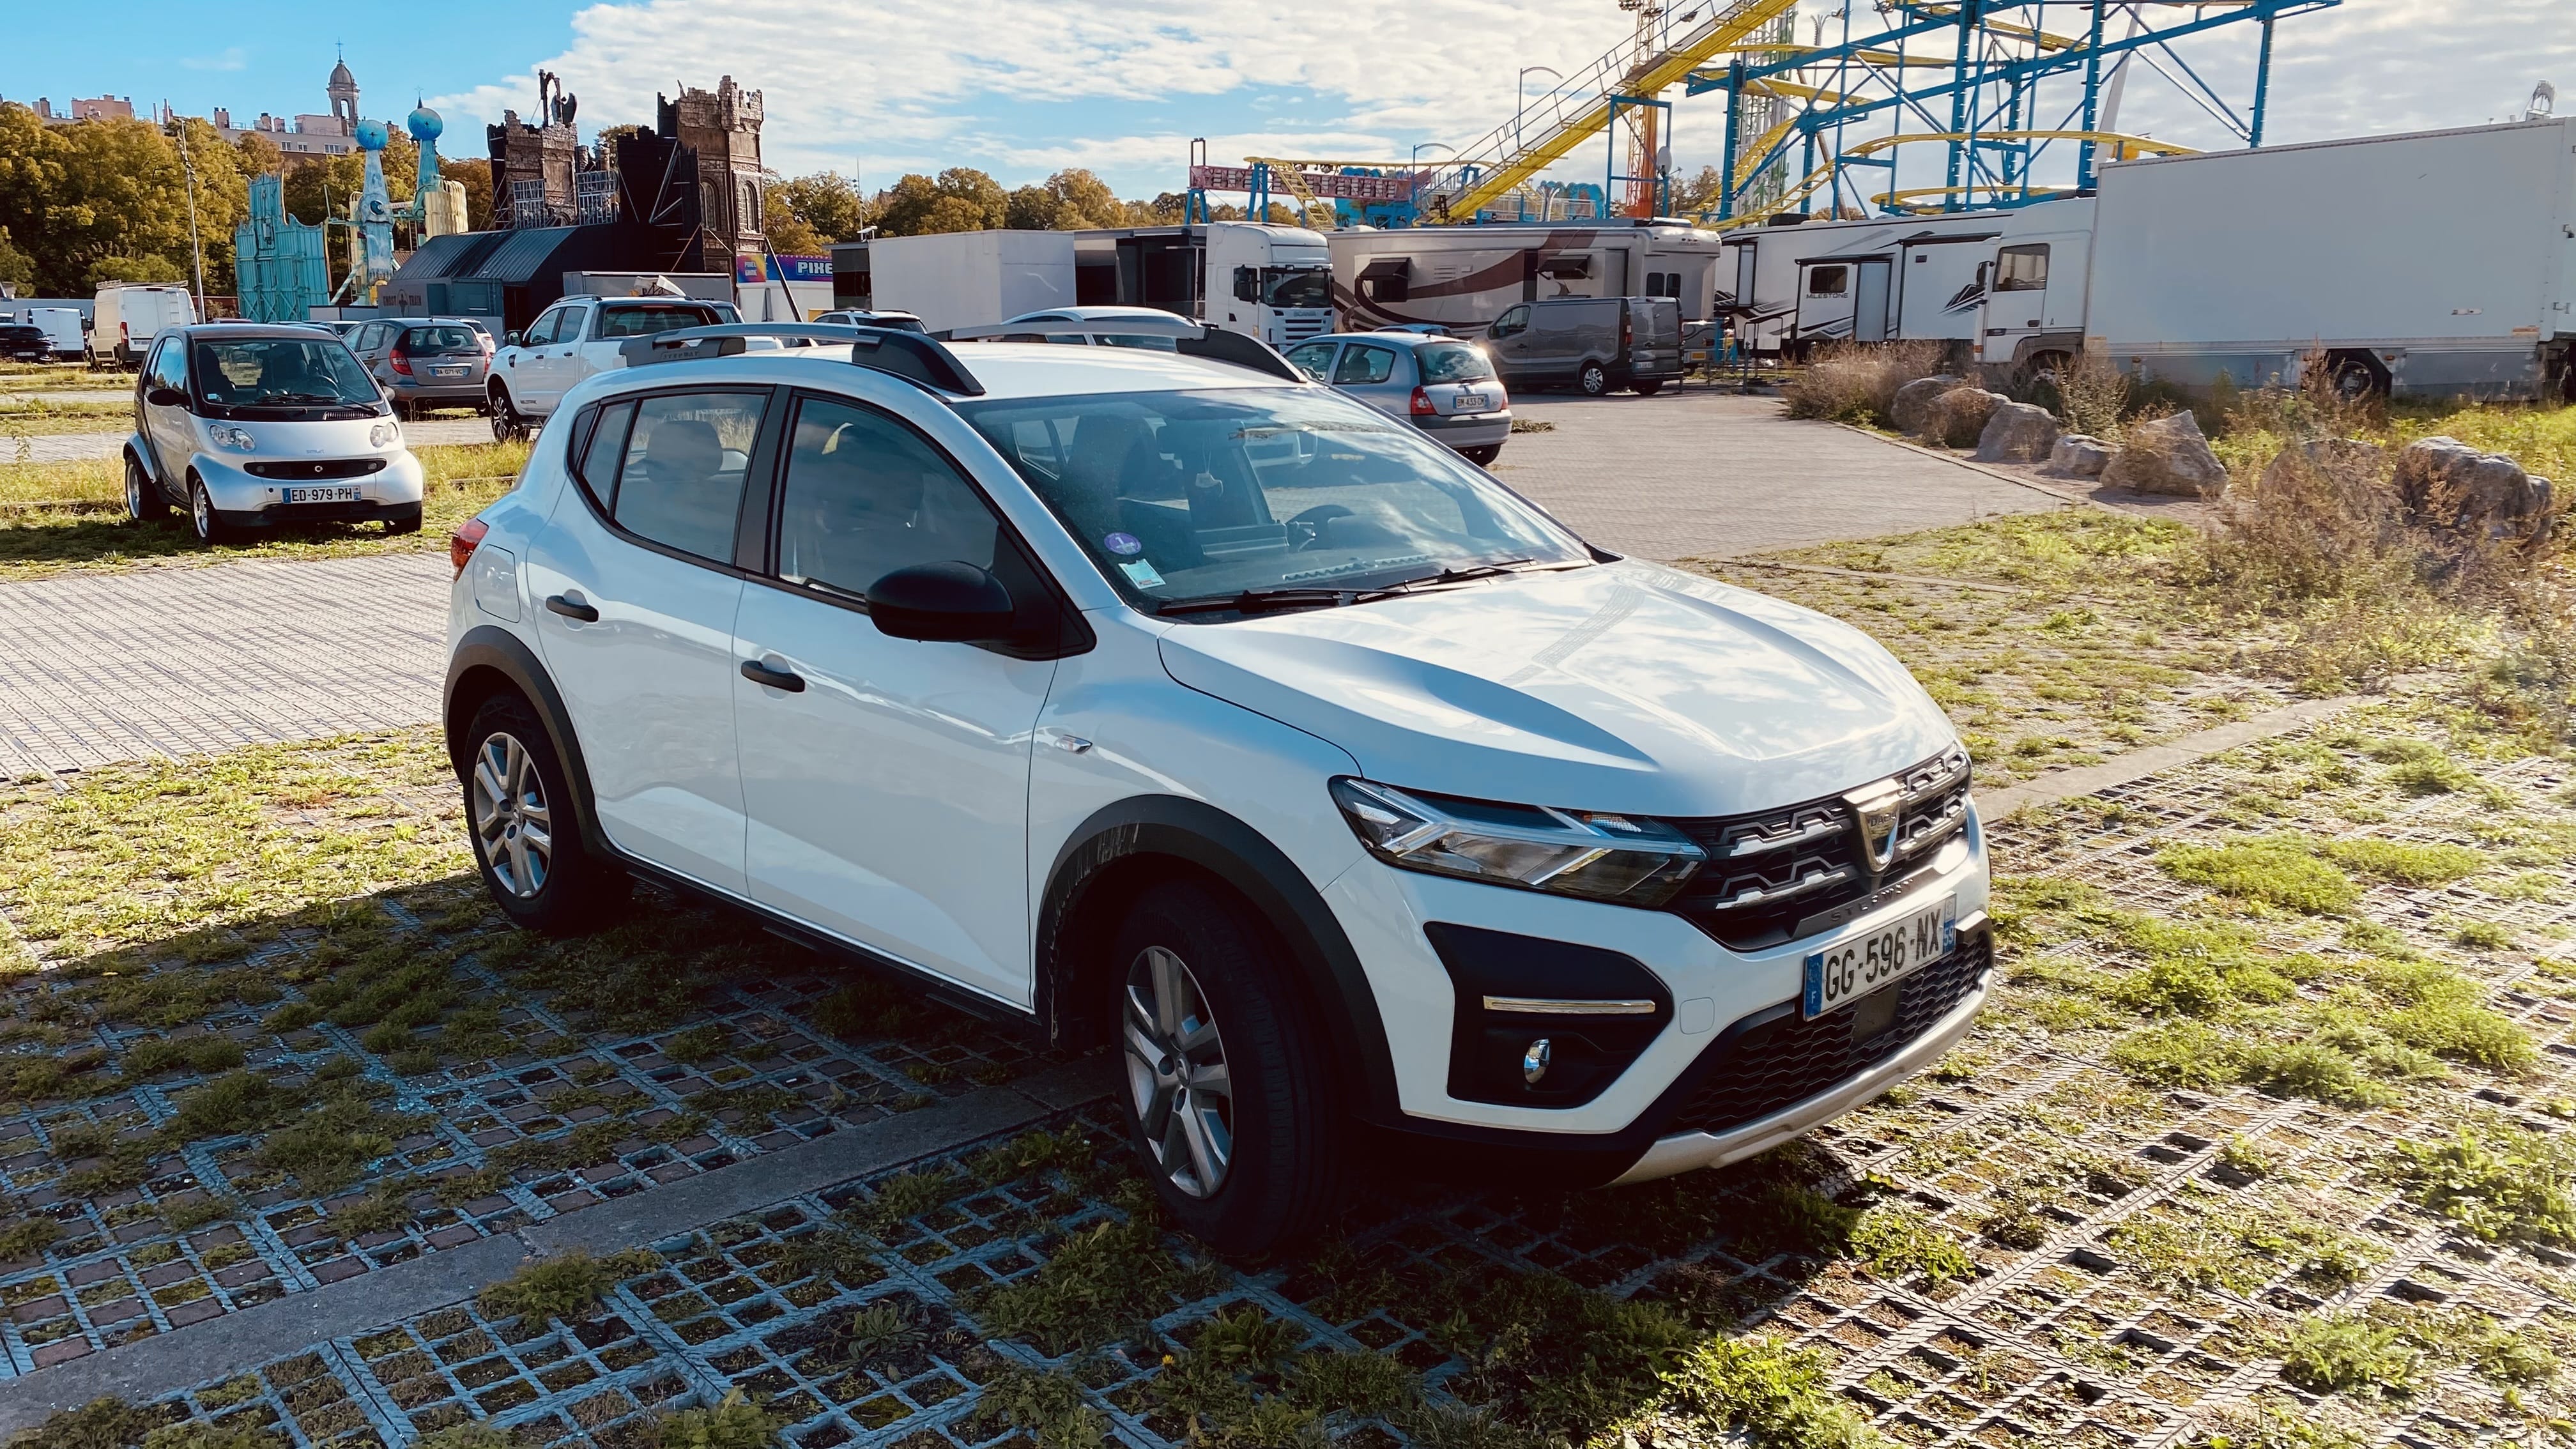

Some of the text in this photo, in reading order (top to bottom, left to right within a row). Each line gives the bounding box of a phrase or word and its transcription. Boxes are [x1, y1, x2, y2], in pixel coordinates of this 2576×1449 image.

[409, 295, 421, 305] TRAIN
[292, 487, 352, 502] ED-979-PH
[1943, 925, 1954, 947] 59
[1825, 908, 1941, 1002] GG-596-NX
[1811, 990, 1816, 1004] F
